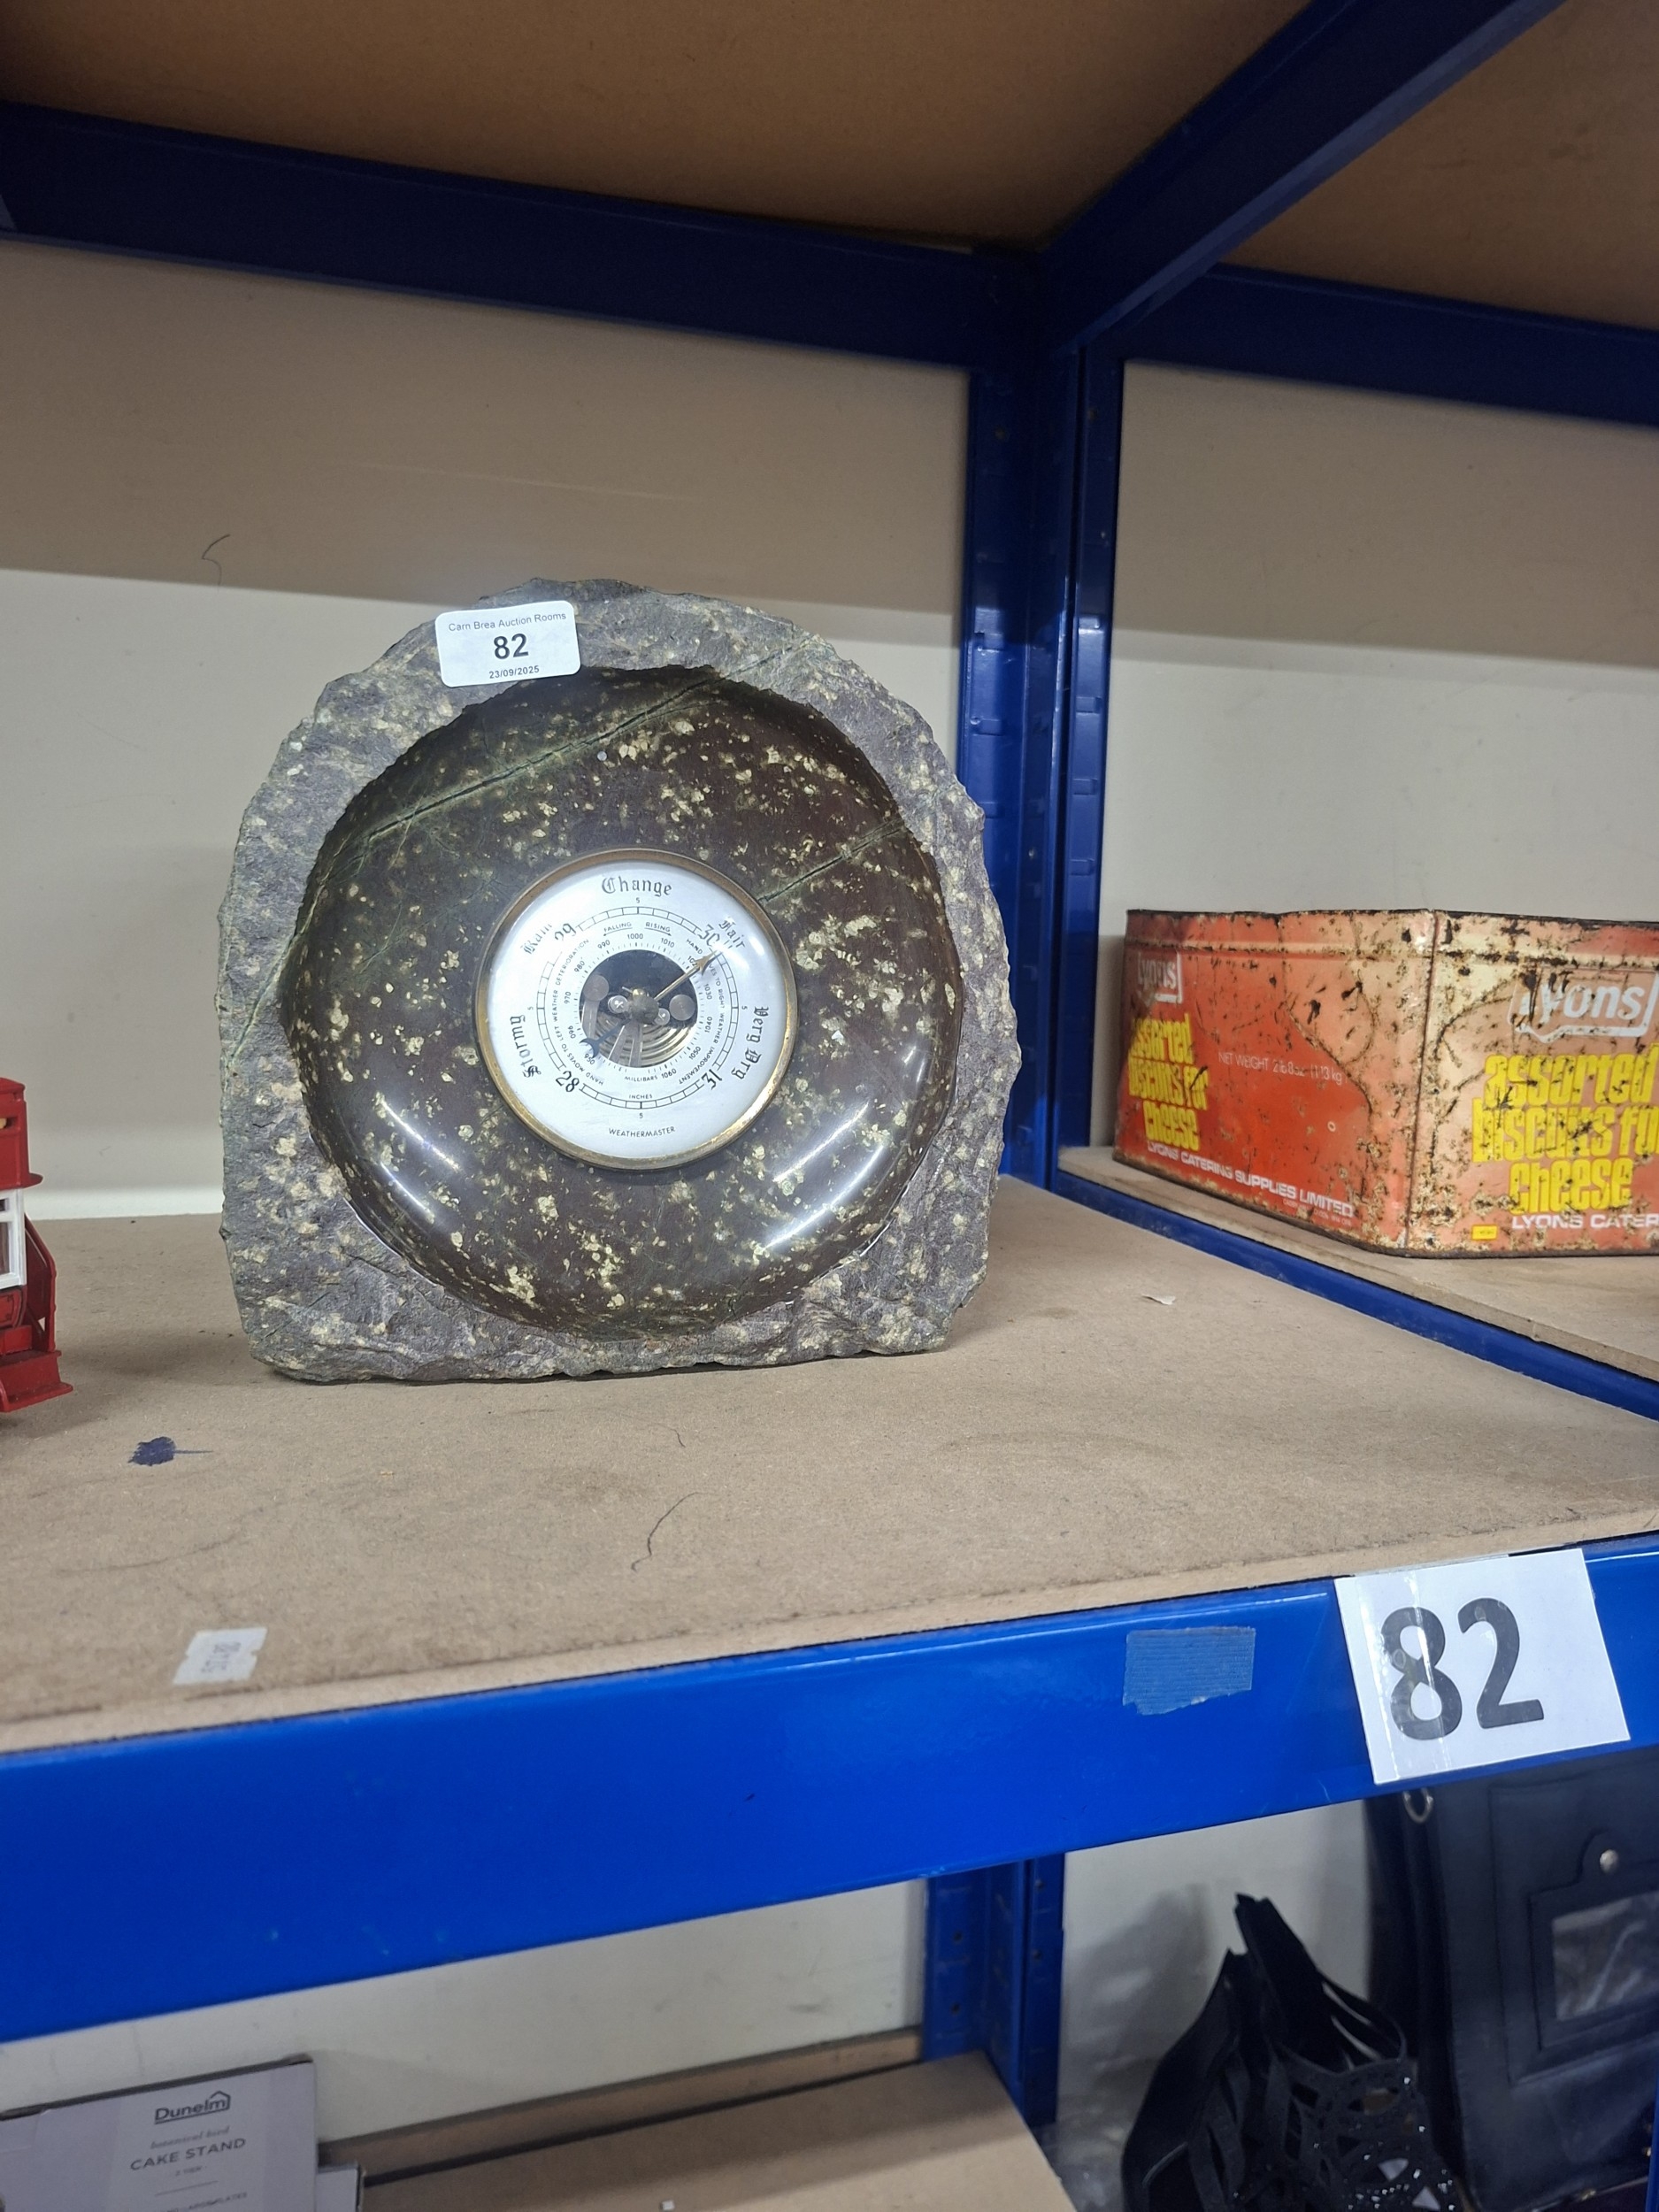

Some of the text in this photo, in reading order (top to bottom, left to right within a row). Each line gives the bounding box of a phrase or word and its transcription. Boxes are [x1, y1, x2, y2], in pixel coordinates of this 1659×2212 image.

[449, 612, 567, 632] Carn Brea Auction Rooms
[494, 633, 529, 660] 82
[488, 665, 540, 680] 23/09/2025
[602, 875, 672, 897] Change
[603, 921, 632, 933] FALLING
[645, 921, 671, 933] RISING
[718, 917, 746, 949] Fair
[597, 940, 611, 949] 990
[661, 938, 675, 949] 1010
[686, 938, 703, 955] HAND
[574, 960, 585, 973] 980
[703, 983, 712, 1000] 1030
[715, 978, 721, 987] TO
[554, 1025, 564, 1041] LEFT
[567, 1025, 576, 1039] 960
[704, 1016, 713, 1033] 1040
[713, 1013, 725, 1044] WEATHER
[510, 1015, 541, 1079] Stormy
[561, 1043, 568, 1052] TO
[731, 1006, 770, 1079] Very Dry
[567, 1052, 584, 1071] MOVES
[688, 1046, 702, 1060] 1050
[1218, 1051, 1233, 1065] NET
[1235, 1054, 1269, 1071] WEIGHT
[661, 1068, 677, 1079] 1060
[679, 1047, 715, 1085] IMPROVEMENT
[1485, 1042, 1659, 1107] assorted
[555, 1070, 580, 1093] 28
[585, 1071, 604, 1086] HAND
[701, 1068, 722, 1090] 31
[609, 1125, 676, 1138] WEATHERMASTER
[1143, 1100, 1200, 1151] cheese
[1471, 1097, 1659, 1163] biscuits fo
[1148, 1141, 1179, 1161] LYONS
[1180, 1150, 1233, 1179] CATERING
[1234, 1169, 1296, 1199] SUPPLIES
[1299, 1187, 1354, 1217] LIMITED
[1509, 1156, 1633, 1215] cheese
[1512, 1214, 1584, 1229] LYONS
[1380, 1597, 1544, 1740] 82
[155, 2097, 228, 2122] Dunelm
[130, 2138, 246, 2170] CAKE STAND
